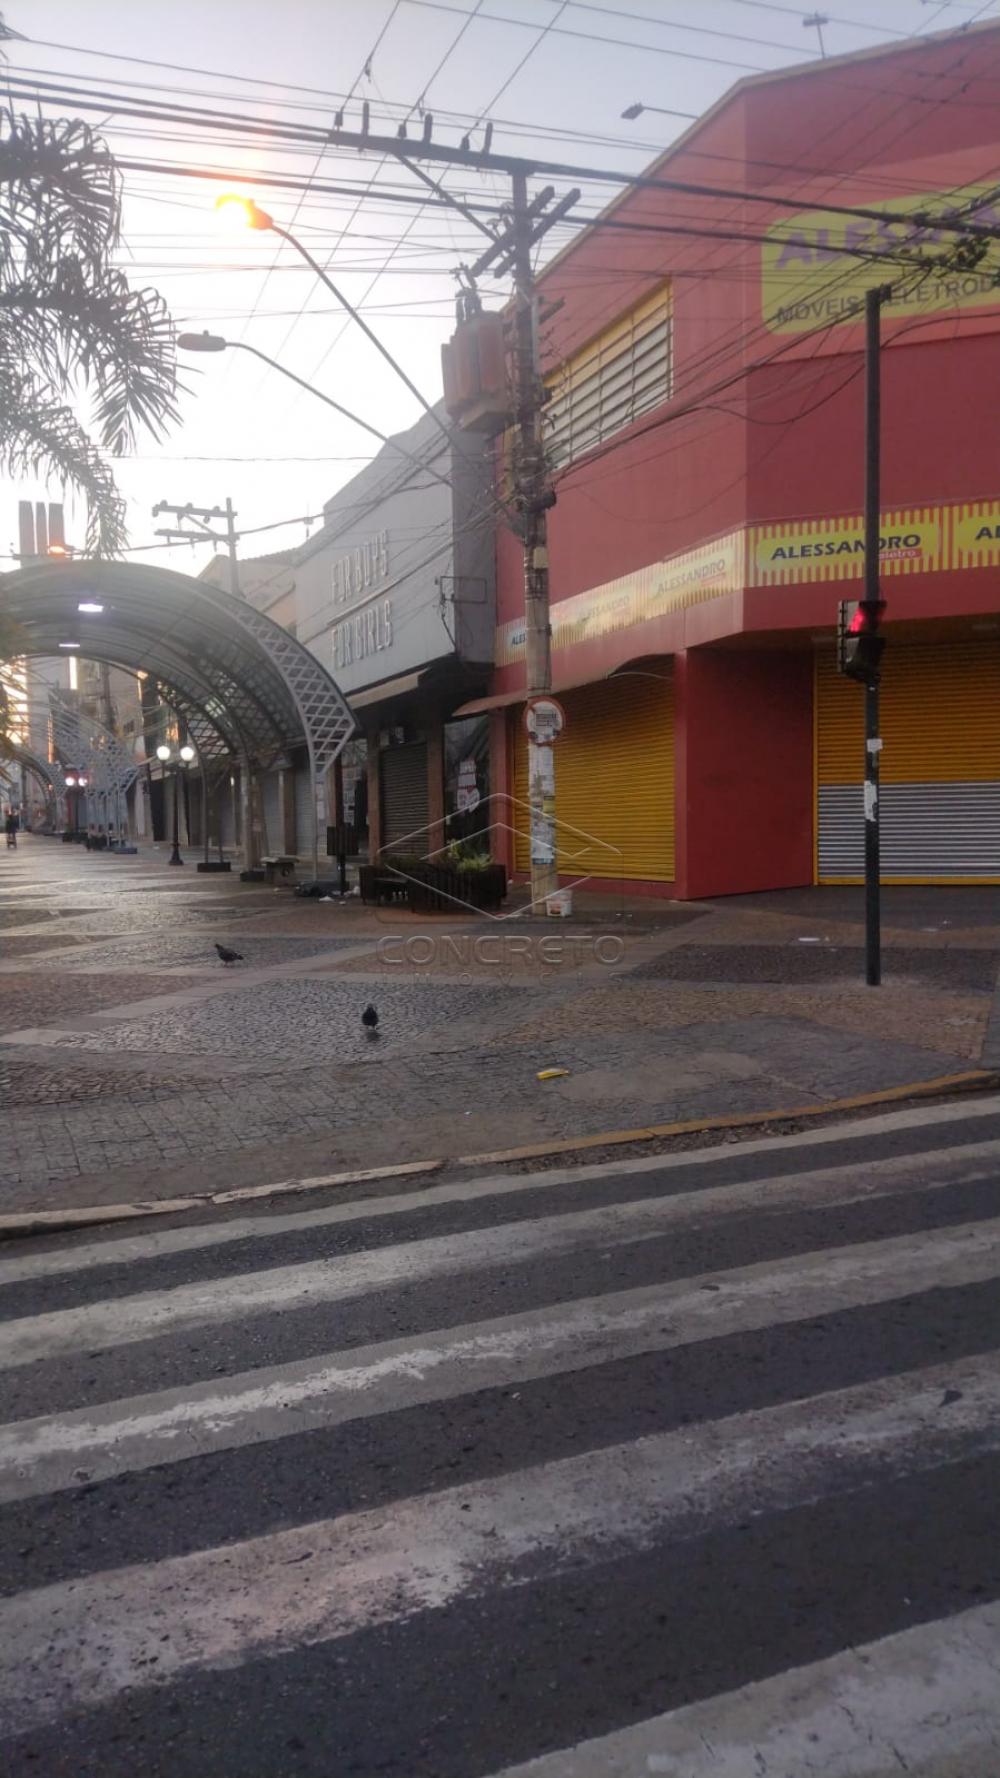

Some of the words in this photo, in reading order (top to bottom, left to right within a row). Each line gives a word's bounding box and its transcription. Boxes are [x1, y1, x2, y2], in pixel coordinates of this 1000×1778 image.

[331, 556, 352, 604] FOR
[355, 528, 388, 593] BOYS
[657, 558, 727, 595] ALESSANDRO
[331, 622, 353, 669] FOR
[355, 599, 393, 660] GIRLS
